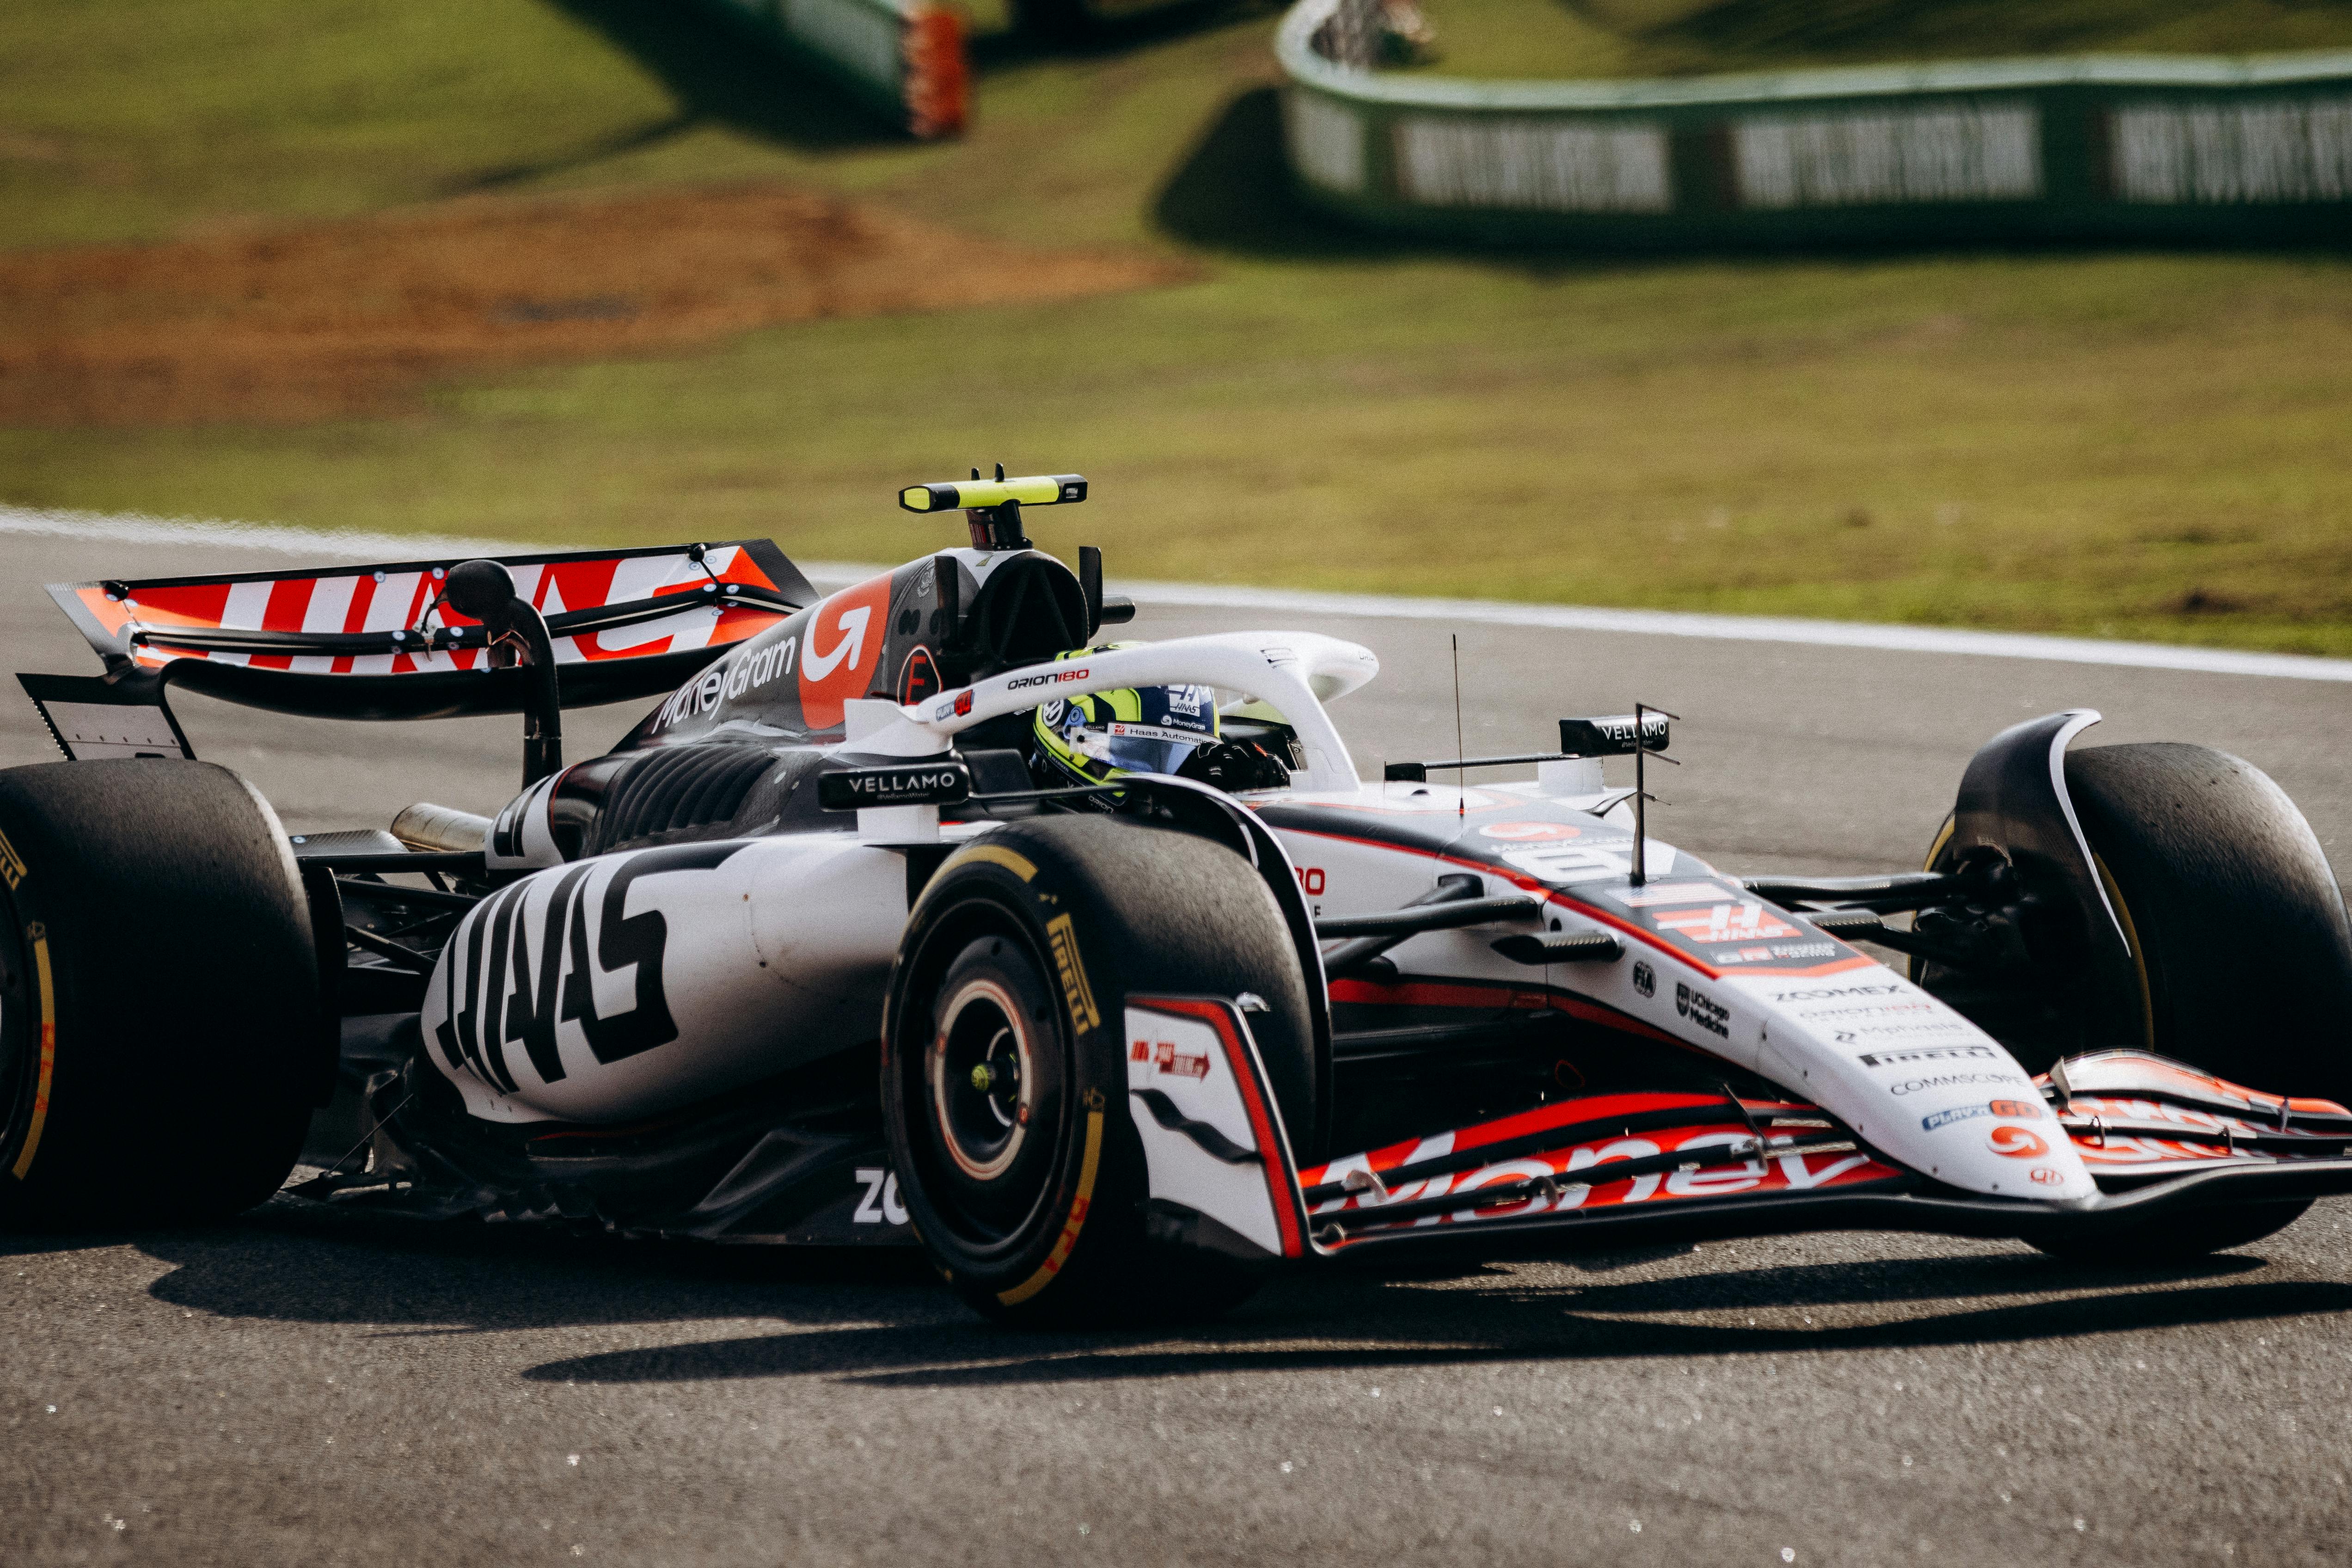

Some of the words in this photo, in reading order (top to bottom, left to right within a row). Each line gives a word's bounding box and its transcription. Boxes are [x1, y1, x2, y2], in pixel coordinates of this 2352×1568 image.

[652, 636, 796, 734] MoneyGram
[1008, 668, 1089, 690] ORION180
[1170, 703, 1200, 713] HAAS
[1130, 728, 1158, 737] Haas
[1173, 717, 1206, 730] MoneyGram
[849, 772, 956, 793] VELLAMO
[1046, 912, 1101, 1035] PIRELLI
[1858, 1046, 1998, 1067] PIRELLI
[1890, 1073, 2025, 1096] COMMSCOPE
